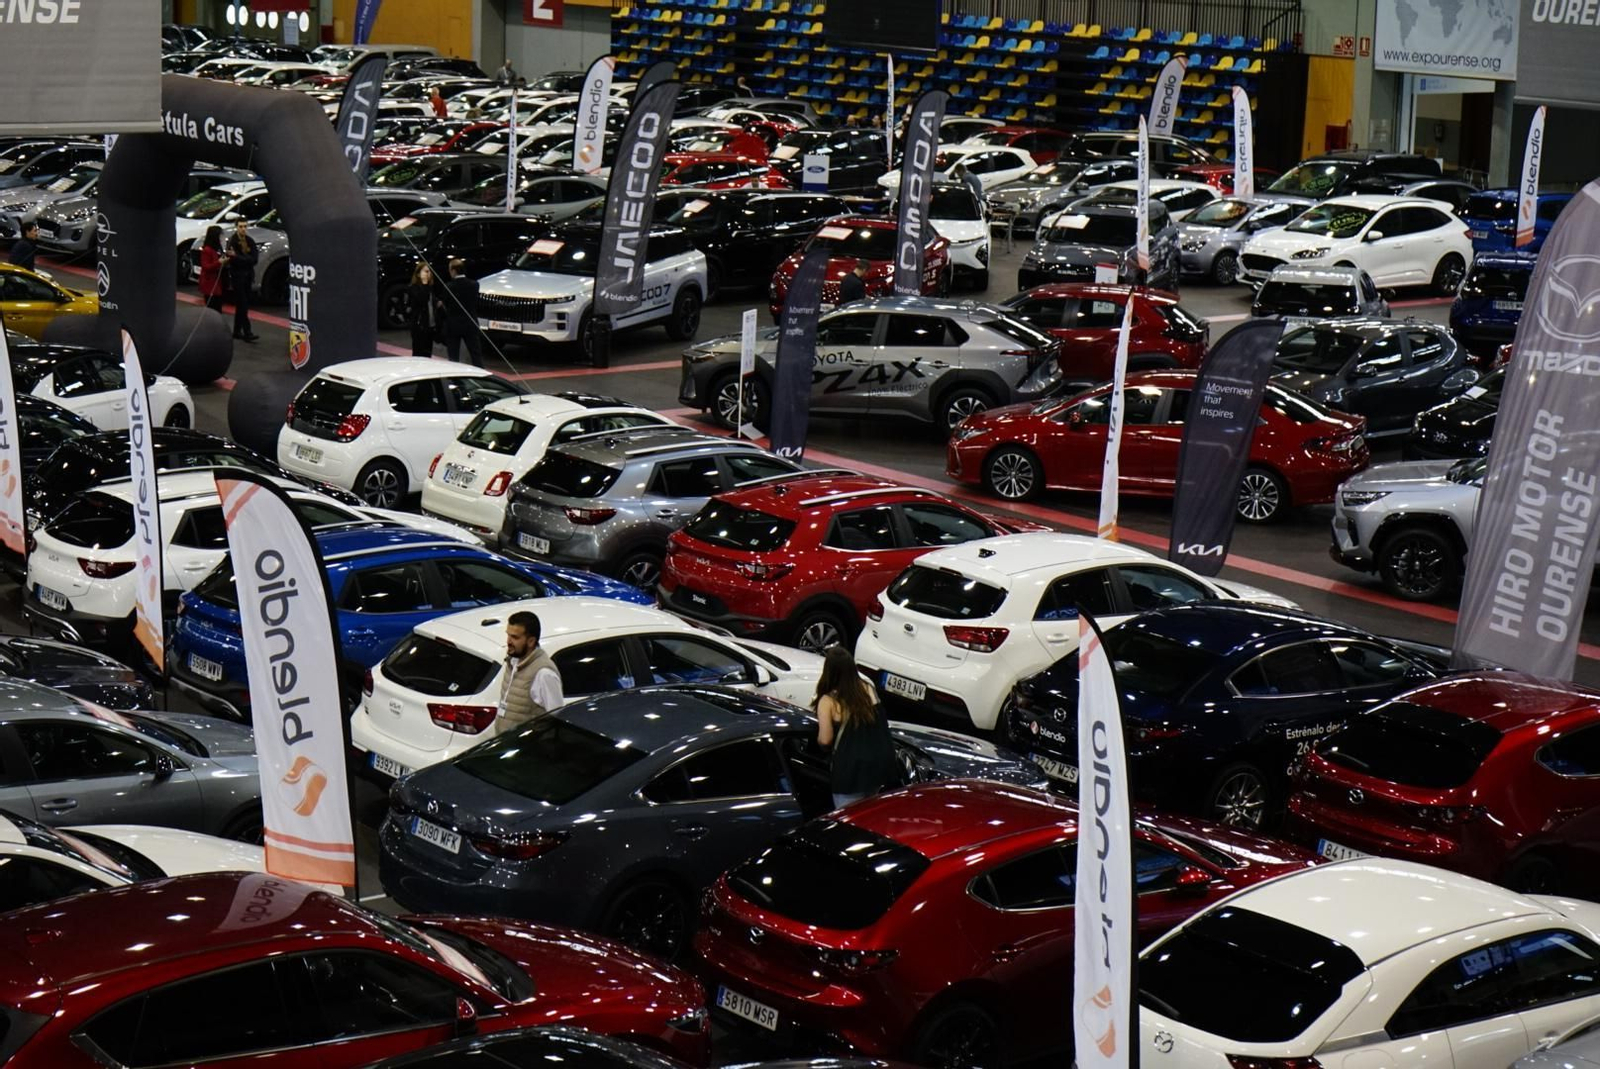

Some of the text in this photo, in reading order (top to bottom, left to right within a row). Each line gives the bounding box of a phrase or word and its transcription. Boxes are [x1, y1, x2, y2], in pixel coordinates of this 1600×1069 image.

[0, 0, 81, 24] NSE
[1383, 48, 1502, 72] www.expourense.org
[586, 77, 604, 142] blendio
[1155, 74, 1177, 129] blendio
[203, 115, 245, 148] Cars
[1526, 127, 1541, 196] blendio
[613, 111, 661, 285] JAECOO
[899, 110, 936, 272] OMODA
[1203, 394, 1223, 405] that
[1206, 381, 1254, 397] Movement
[1200, 405, 1235, 420] inspires
[775, 446, 803, 458] KIA
[1488, 408, 1564, 639] HIRO MOTOR
[1178, 541, 1224, 557] KIA
[1535, 466, 1597, 643] OURENSE
[887, 675, 925, 698] 4383 LNV
[1040, 726, 1067, 743] blendio
[1285, 723, 1325, 740] Estrénalo
[375, 754, 394, 775] 9392
[418, 820, 460, 850] 3090 MFK
[724, 991, 776, 1027] 5810 MSR
